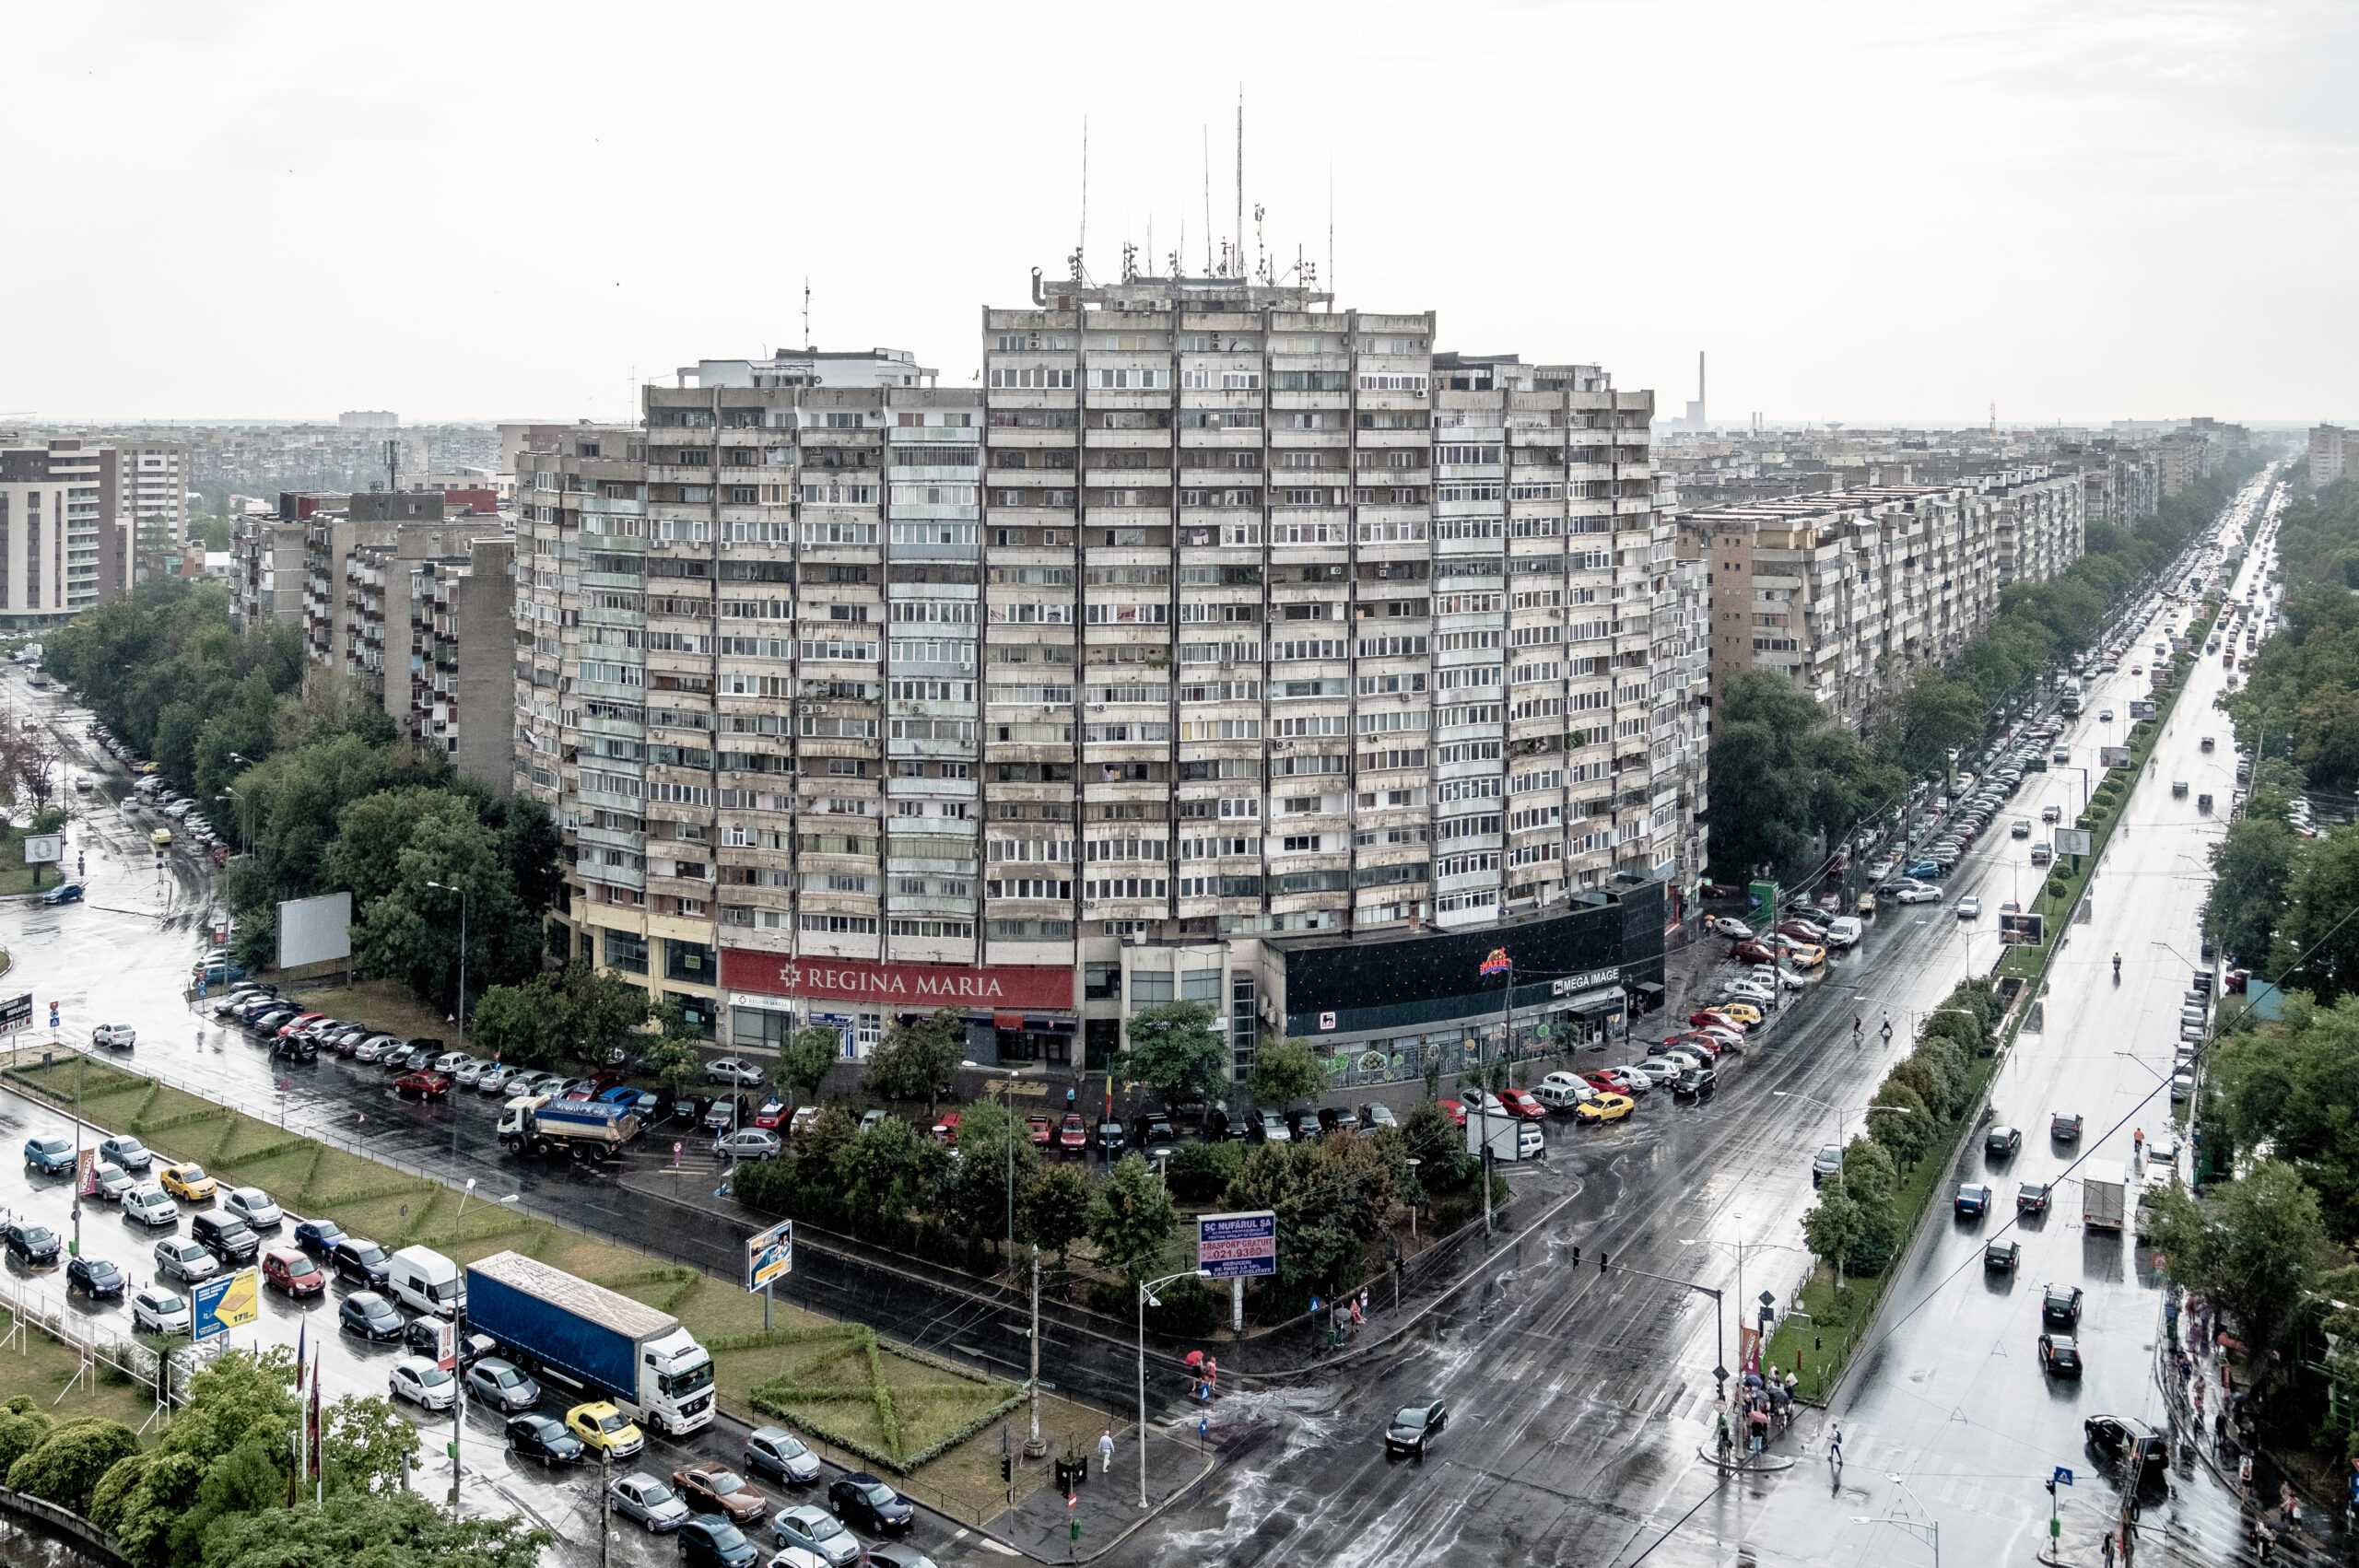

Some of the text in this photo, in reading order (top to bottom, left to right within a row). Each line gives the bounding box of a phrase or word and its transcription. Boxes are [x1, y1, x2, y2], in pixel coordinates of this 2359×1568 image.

[808, 968, 1004, 997] REGINA MARIA
[1564, 968, 1619, 991] MEGA IMAGE
[80, 1153, 93, 1192] HORNBACH
[1260, 1219, 1271, 1227] SA
[1203, 1238, 1273, 1250] TRASPORT GRATUIT
